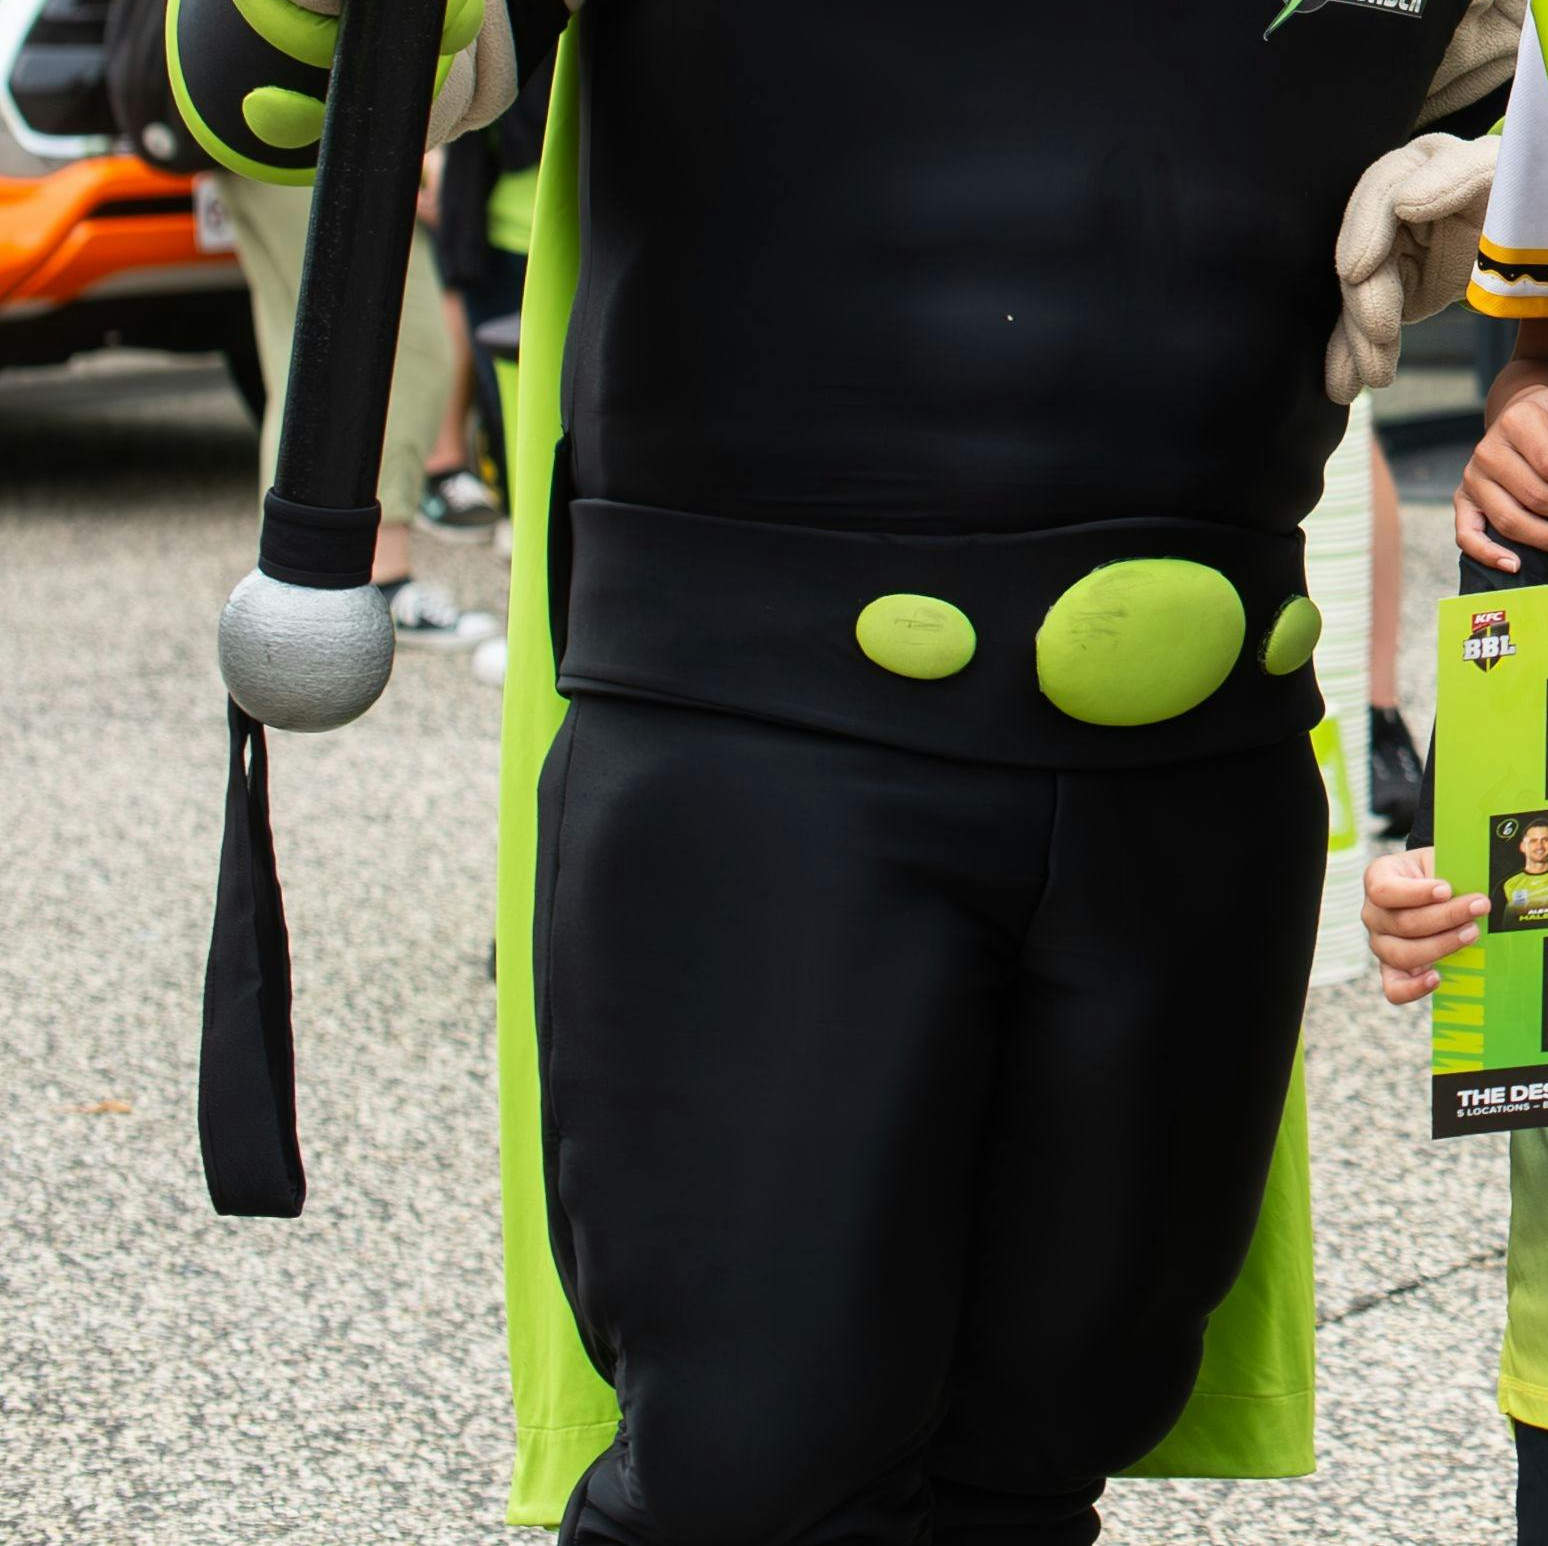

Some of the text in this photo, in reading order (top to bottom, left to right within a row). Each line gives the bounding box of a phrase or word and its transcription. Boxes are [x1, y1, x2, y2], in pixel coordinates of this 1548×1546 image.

[1474, 610, 1503, 625] KFC
[1463, 634, 1517, 661] BBL
[1457, 1086, 1506, 1108] THE
[1467, 1102, 1531, 1117] LOCATIONS
